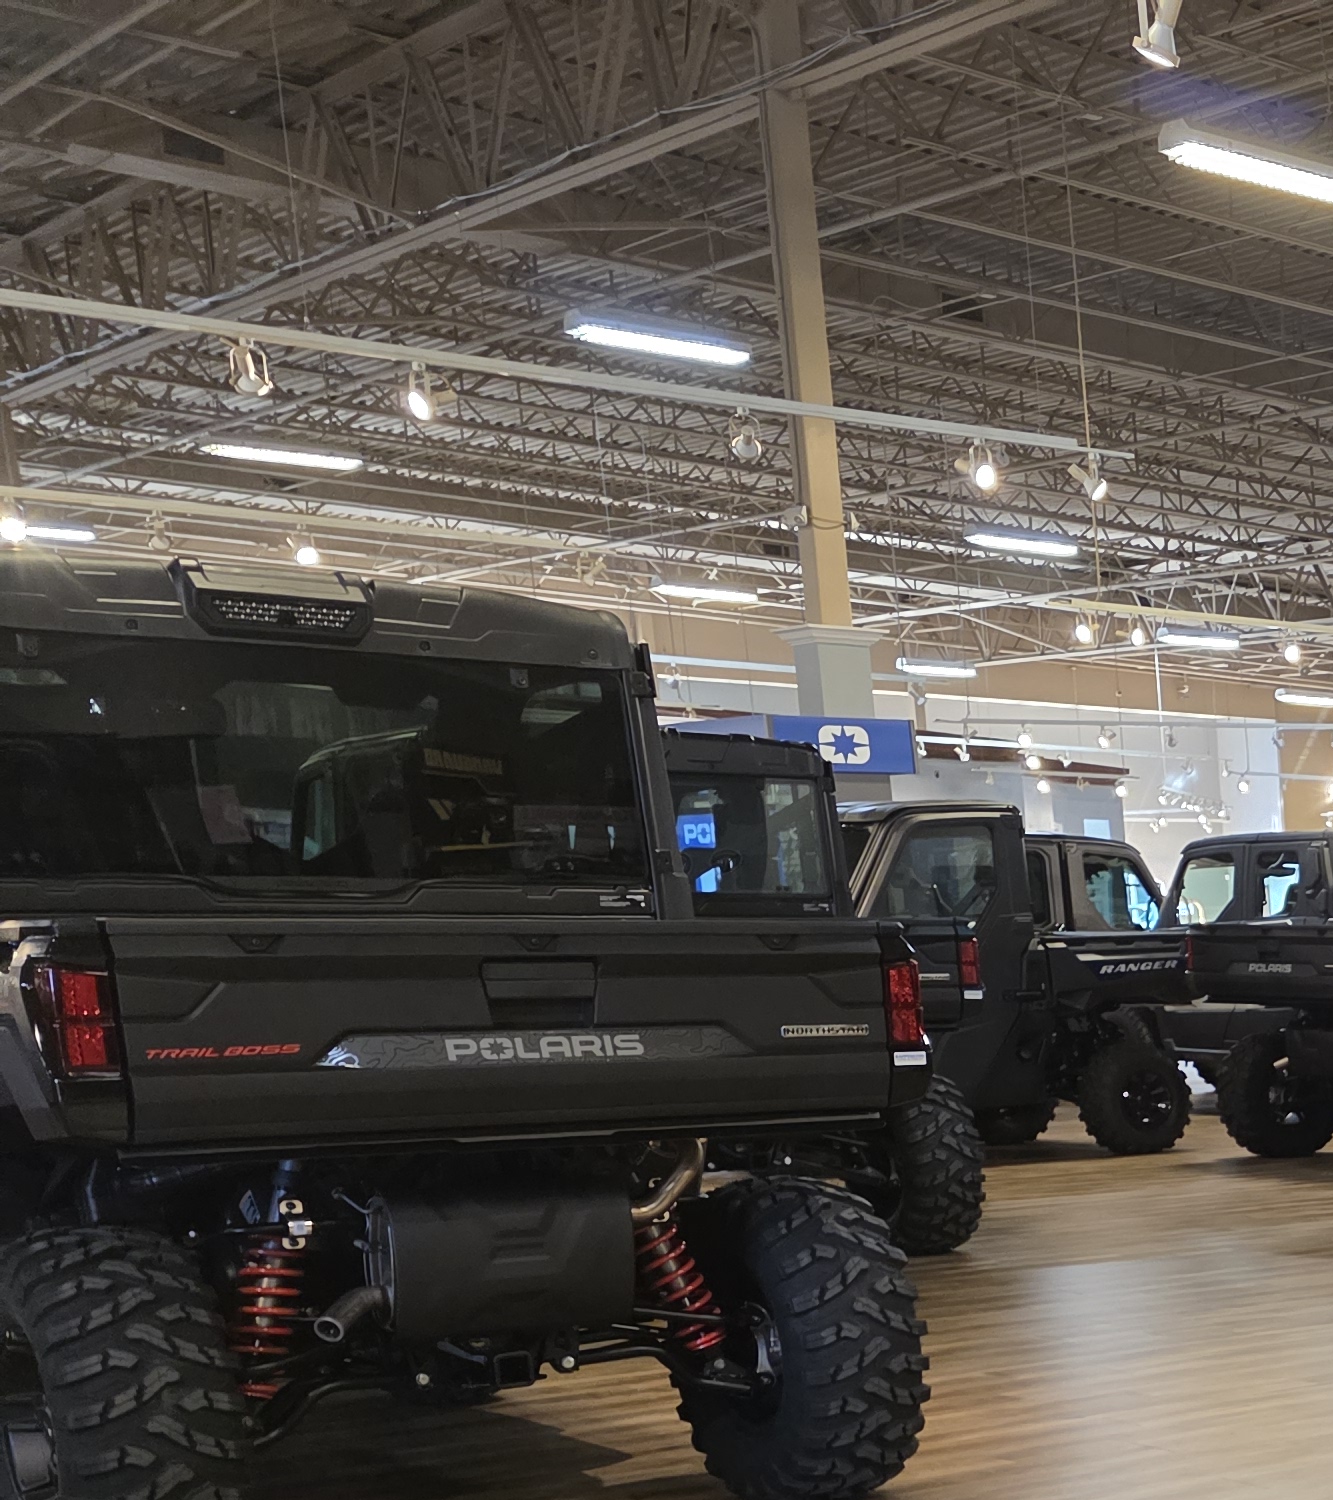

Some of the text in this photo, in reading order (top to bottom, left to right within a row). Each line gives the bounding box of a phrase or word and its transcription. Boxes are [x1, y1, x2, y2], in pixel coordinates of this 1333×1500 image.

[683, 823, 716, 845] PO
[1100, 959, 1178, 975] RANGER
[1249, 963, 1292, 973] POLARIS
[786, 1026, 867, 1036] NORTHSTAR
[145, 1043, 301, 1060] TRAIL BOSS
[445, 1034, 645, 1062] POLARIS
